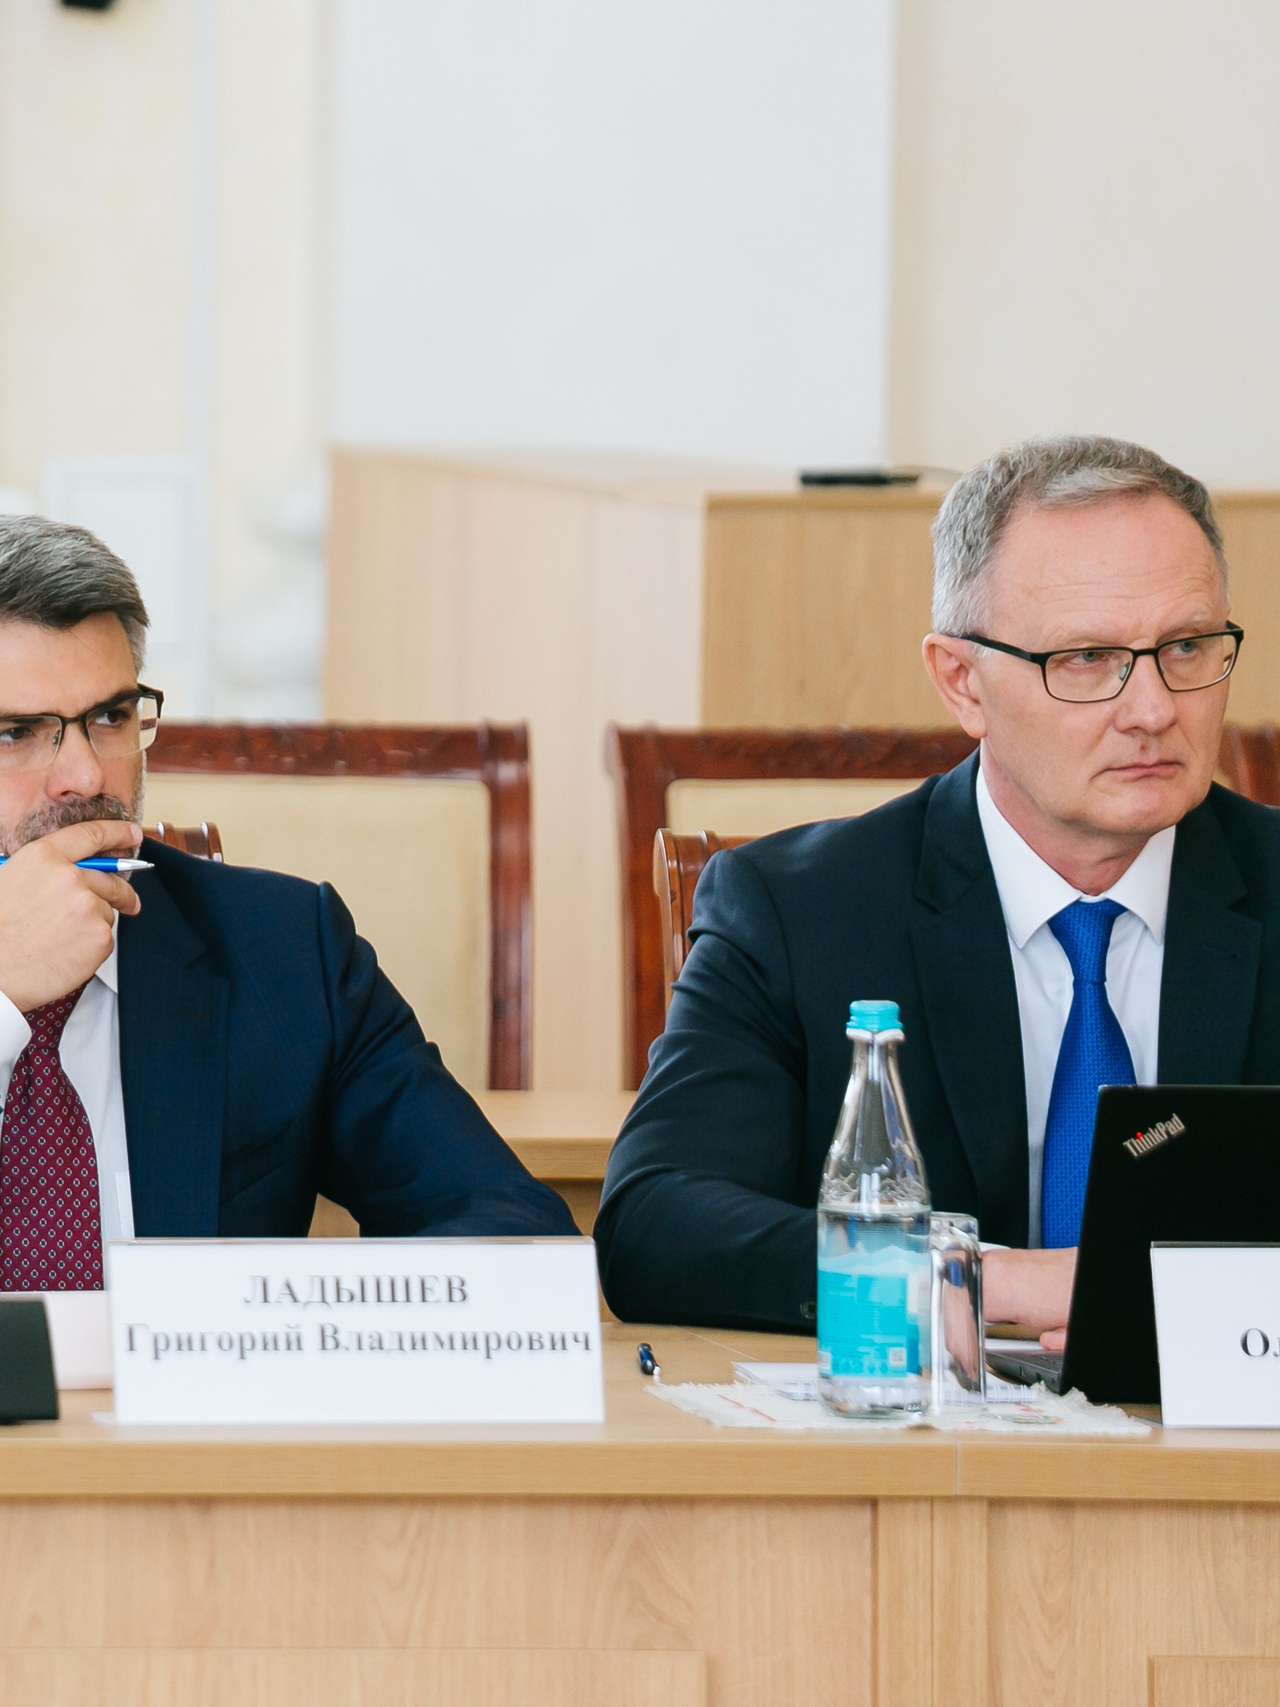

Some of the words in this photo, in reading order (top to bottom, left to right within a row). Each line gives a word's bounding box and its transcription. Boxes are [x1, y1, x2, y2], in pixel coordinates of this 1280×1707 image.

[1122, 1112, 1186, 1157] ThinkPad
[243, 1274, 470, 1309] ЛАДЫШЕВ
[126, 1323, 305, 1361] Григорий
[319, 1323, 593, 1360] Владимирович
